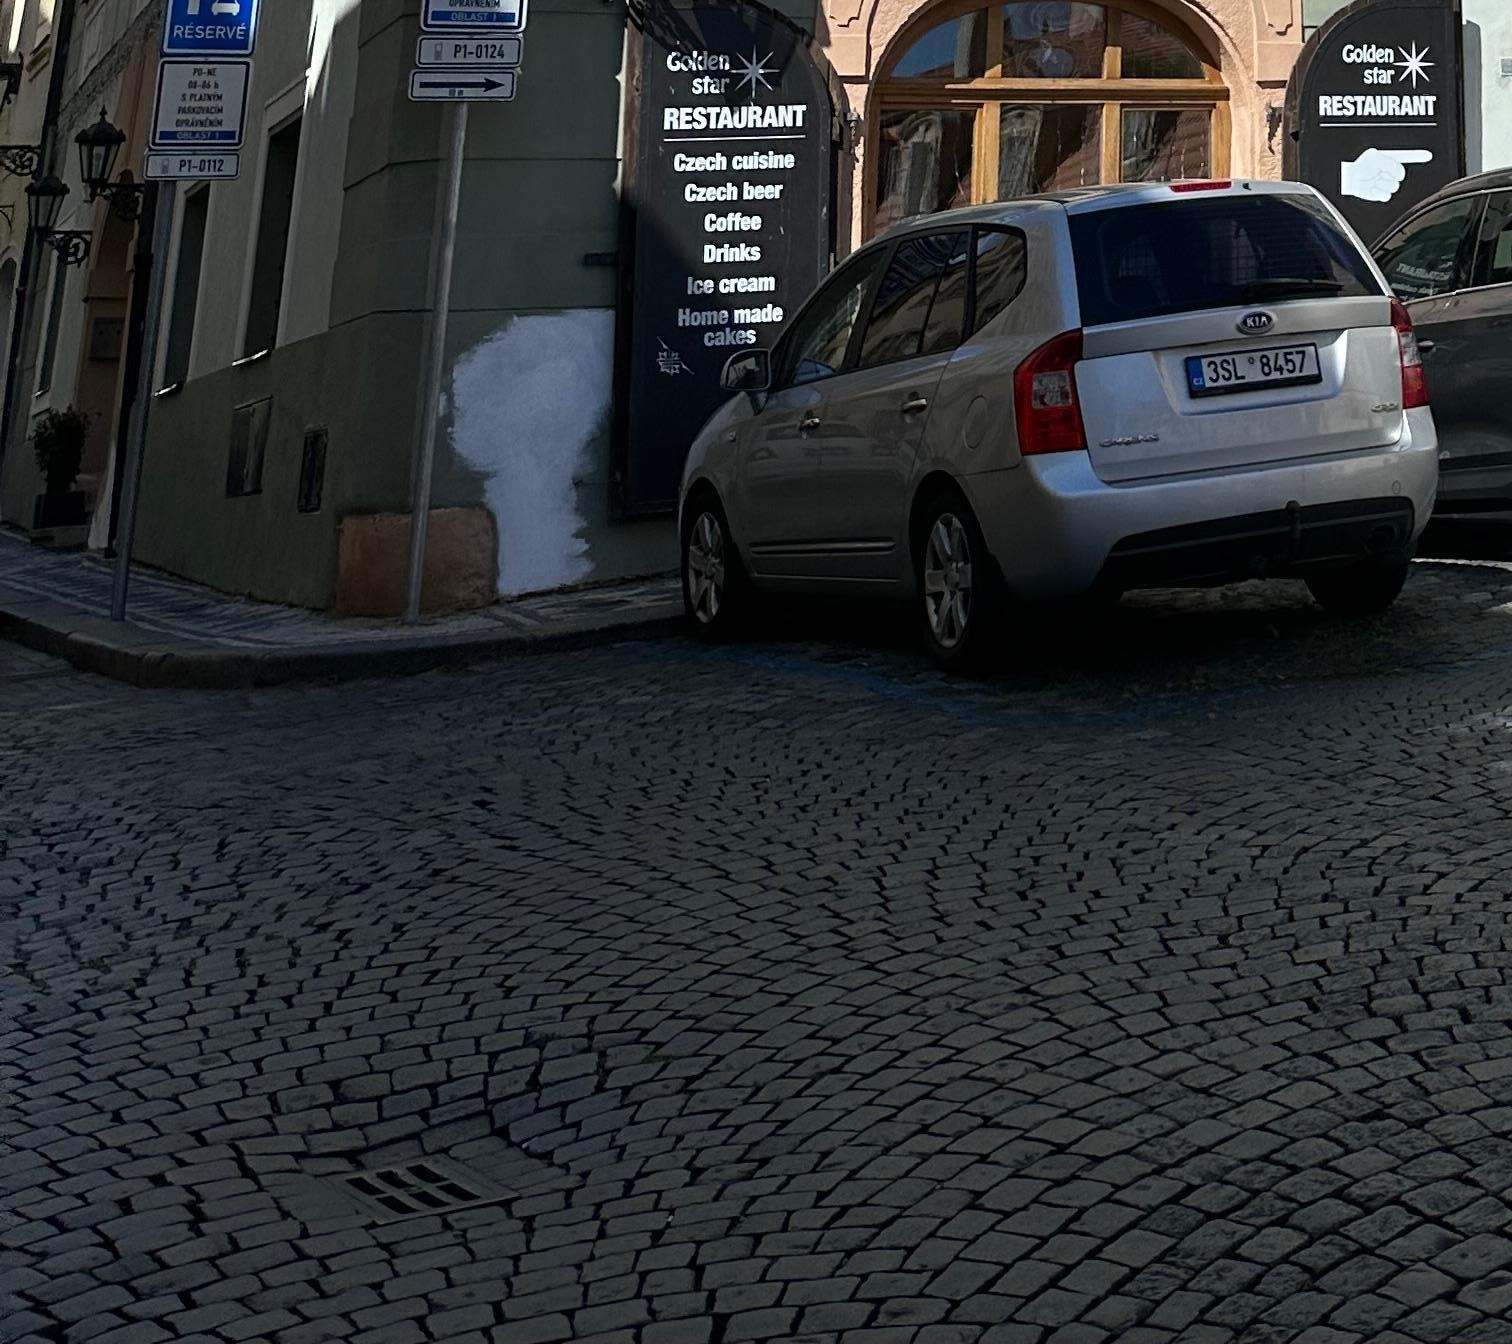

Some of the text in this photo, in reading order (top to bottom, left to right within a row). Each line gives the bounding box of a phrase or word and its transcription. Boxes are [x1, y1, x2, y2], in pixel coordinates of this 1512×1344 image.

[451, 12, 488, 22] OBLAST
[173, 22, 247, 40] RÉSERVÉ
[453, 43, 505, 59] P1-0124
[666, 50, 730, 72] Golden
[1342, 44, 1395, 64] Golden
[692, 75, 730, 94] star
[1363, 66, 1395, 85] star
[1319, 94, 1437, 117] RESTAURANT
[663, 104, 807, 131] RESTAURANT
[178, 159, 225, 173] P1-0112
[673, 151, 795, 172] Czech cuisine
[684, 182, 784, 202] Czech beer
[704, 212, 762, 232] Coffee
[703, 243, 761, 263] Drinks
[687, 275, 776, 295] Ice cream
[678, 304, 784, 327] Home made
[1245, 315, 1269, 329] KIA
[704, 327, 757, 347] cakes
[1206, 359, 1246, 384] 3SL
[1259, 350, 1307, 378] 8457
